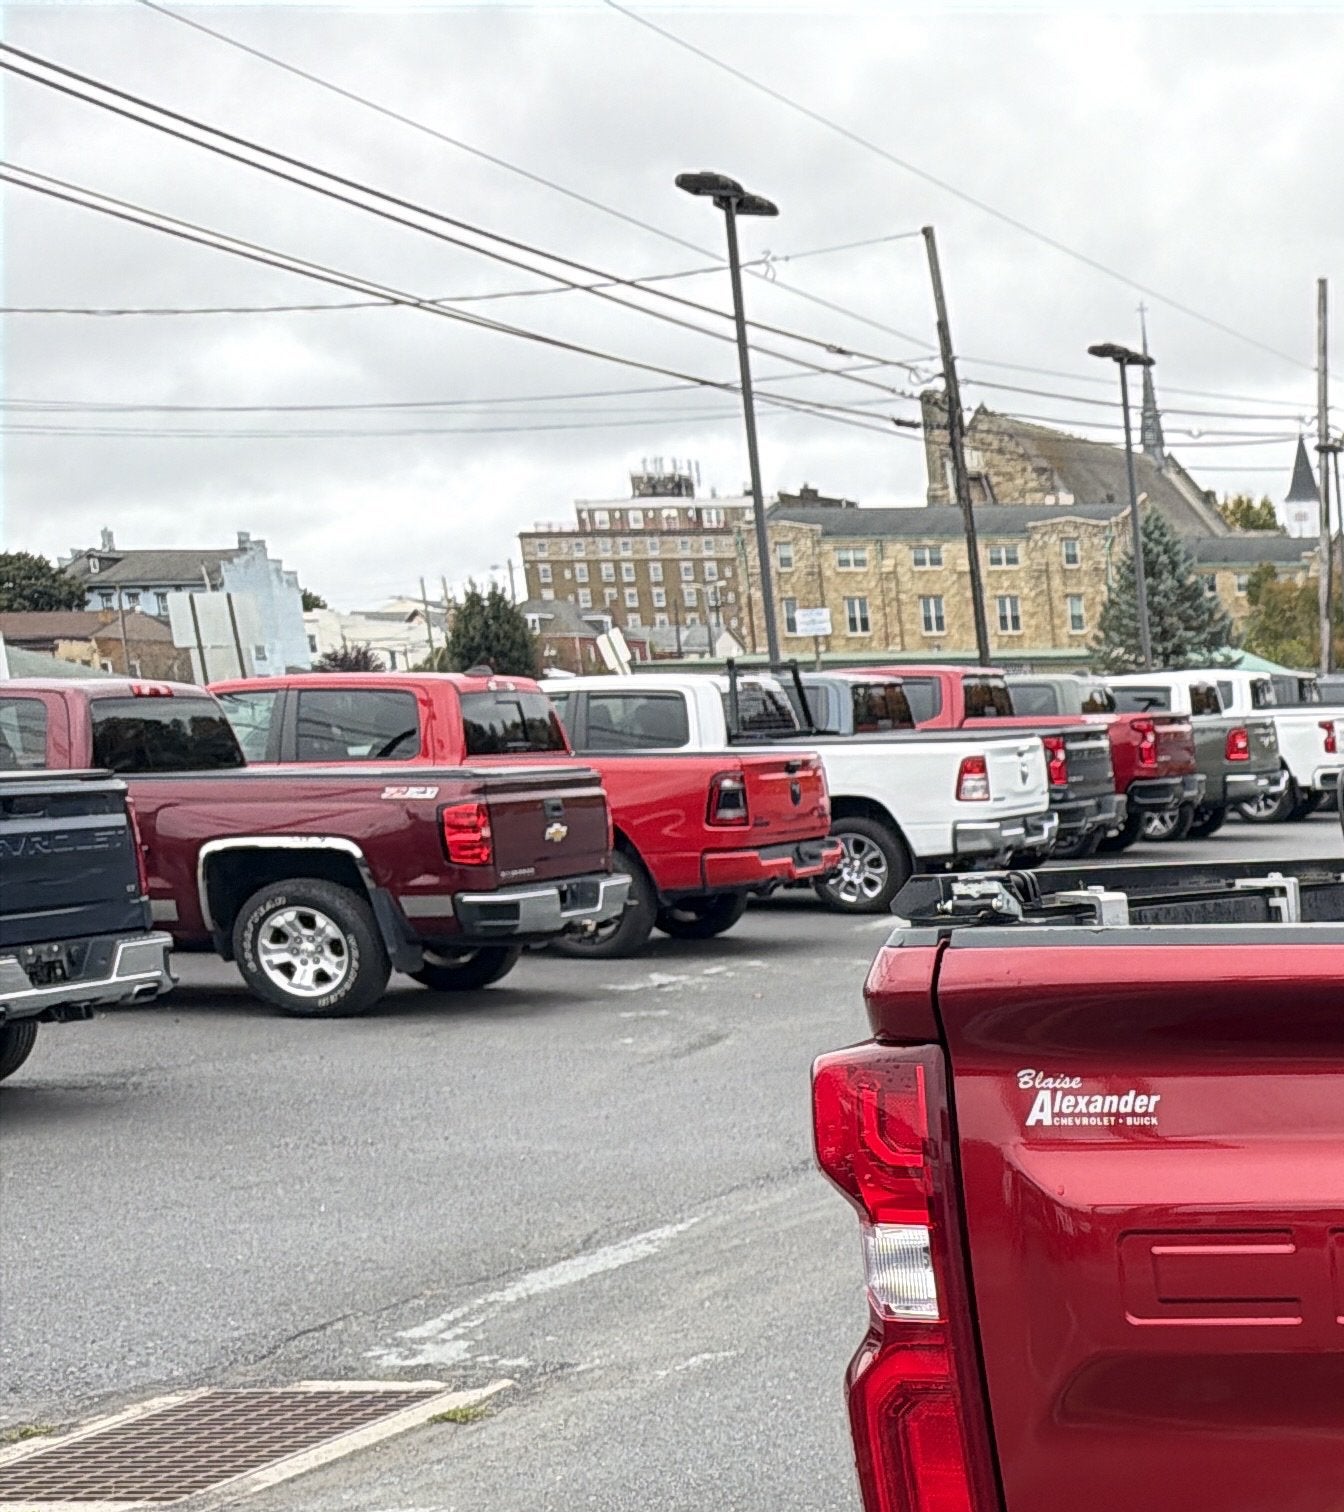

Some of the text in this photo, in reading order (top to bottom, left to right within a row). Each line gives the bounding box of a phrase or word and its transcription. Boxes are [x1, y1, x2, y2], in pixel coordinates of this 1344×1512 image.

[0, 830, 125, 857] VROLET
[1017, 1068, 1082, 1089] Blaise
[1026, 1090, 1160, 1126] Alexander
[1053, 1116, 1158, 1126] CHEVROLET BUICK
